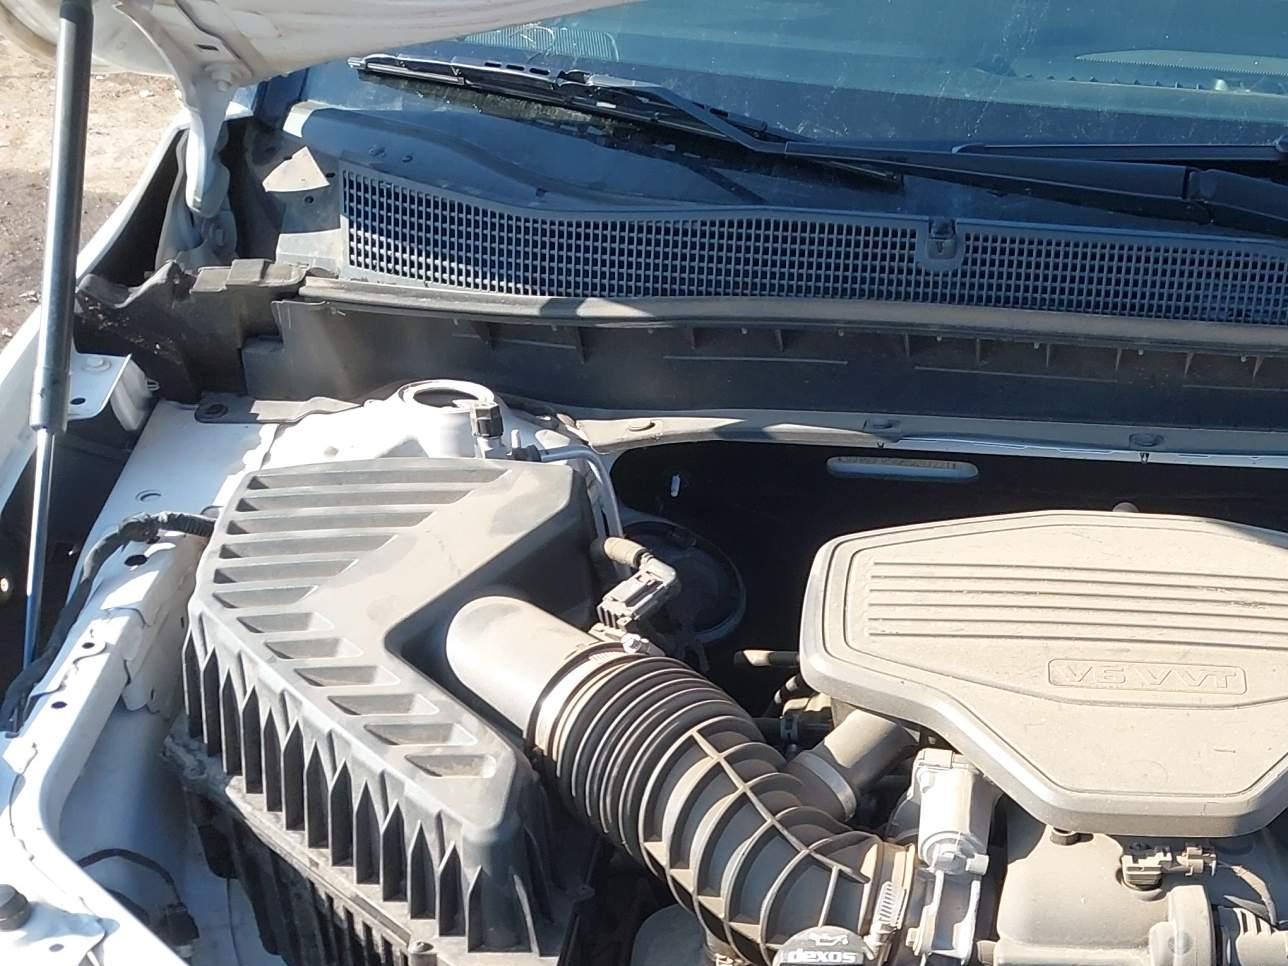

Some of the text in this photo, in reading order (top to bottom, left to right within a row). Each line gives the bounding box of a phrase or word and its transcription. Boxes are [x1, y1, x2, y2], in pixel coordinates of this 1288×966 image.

[1058, 664, 1237, 690] V6 VVT
[787, 948, 857, 963] dexos
